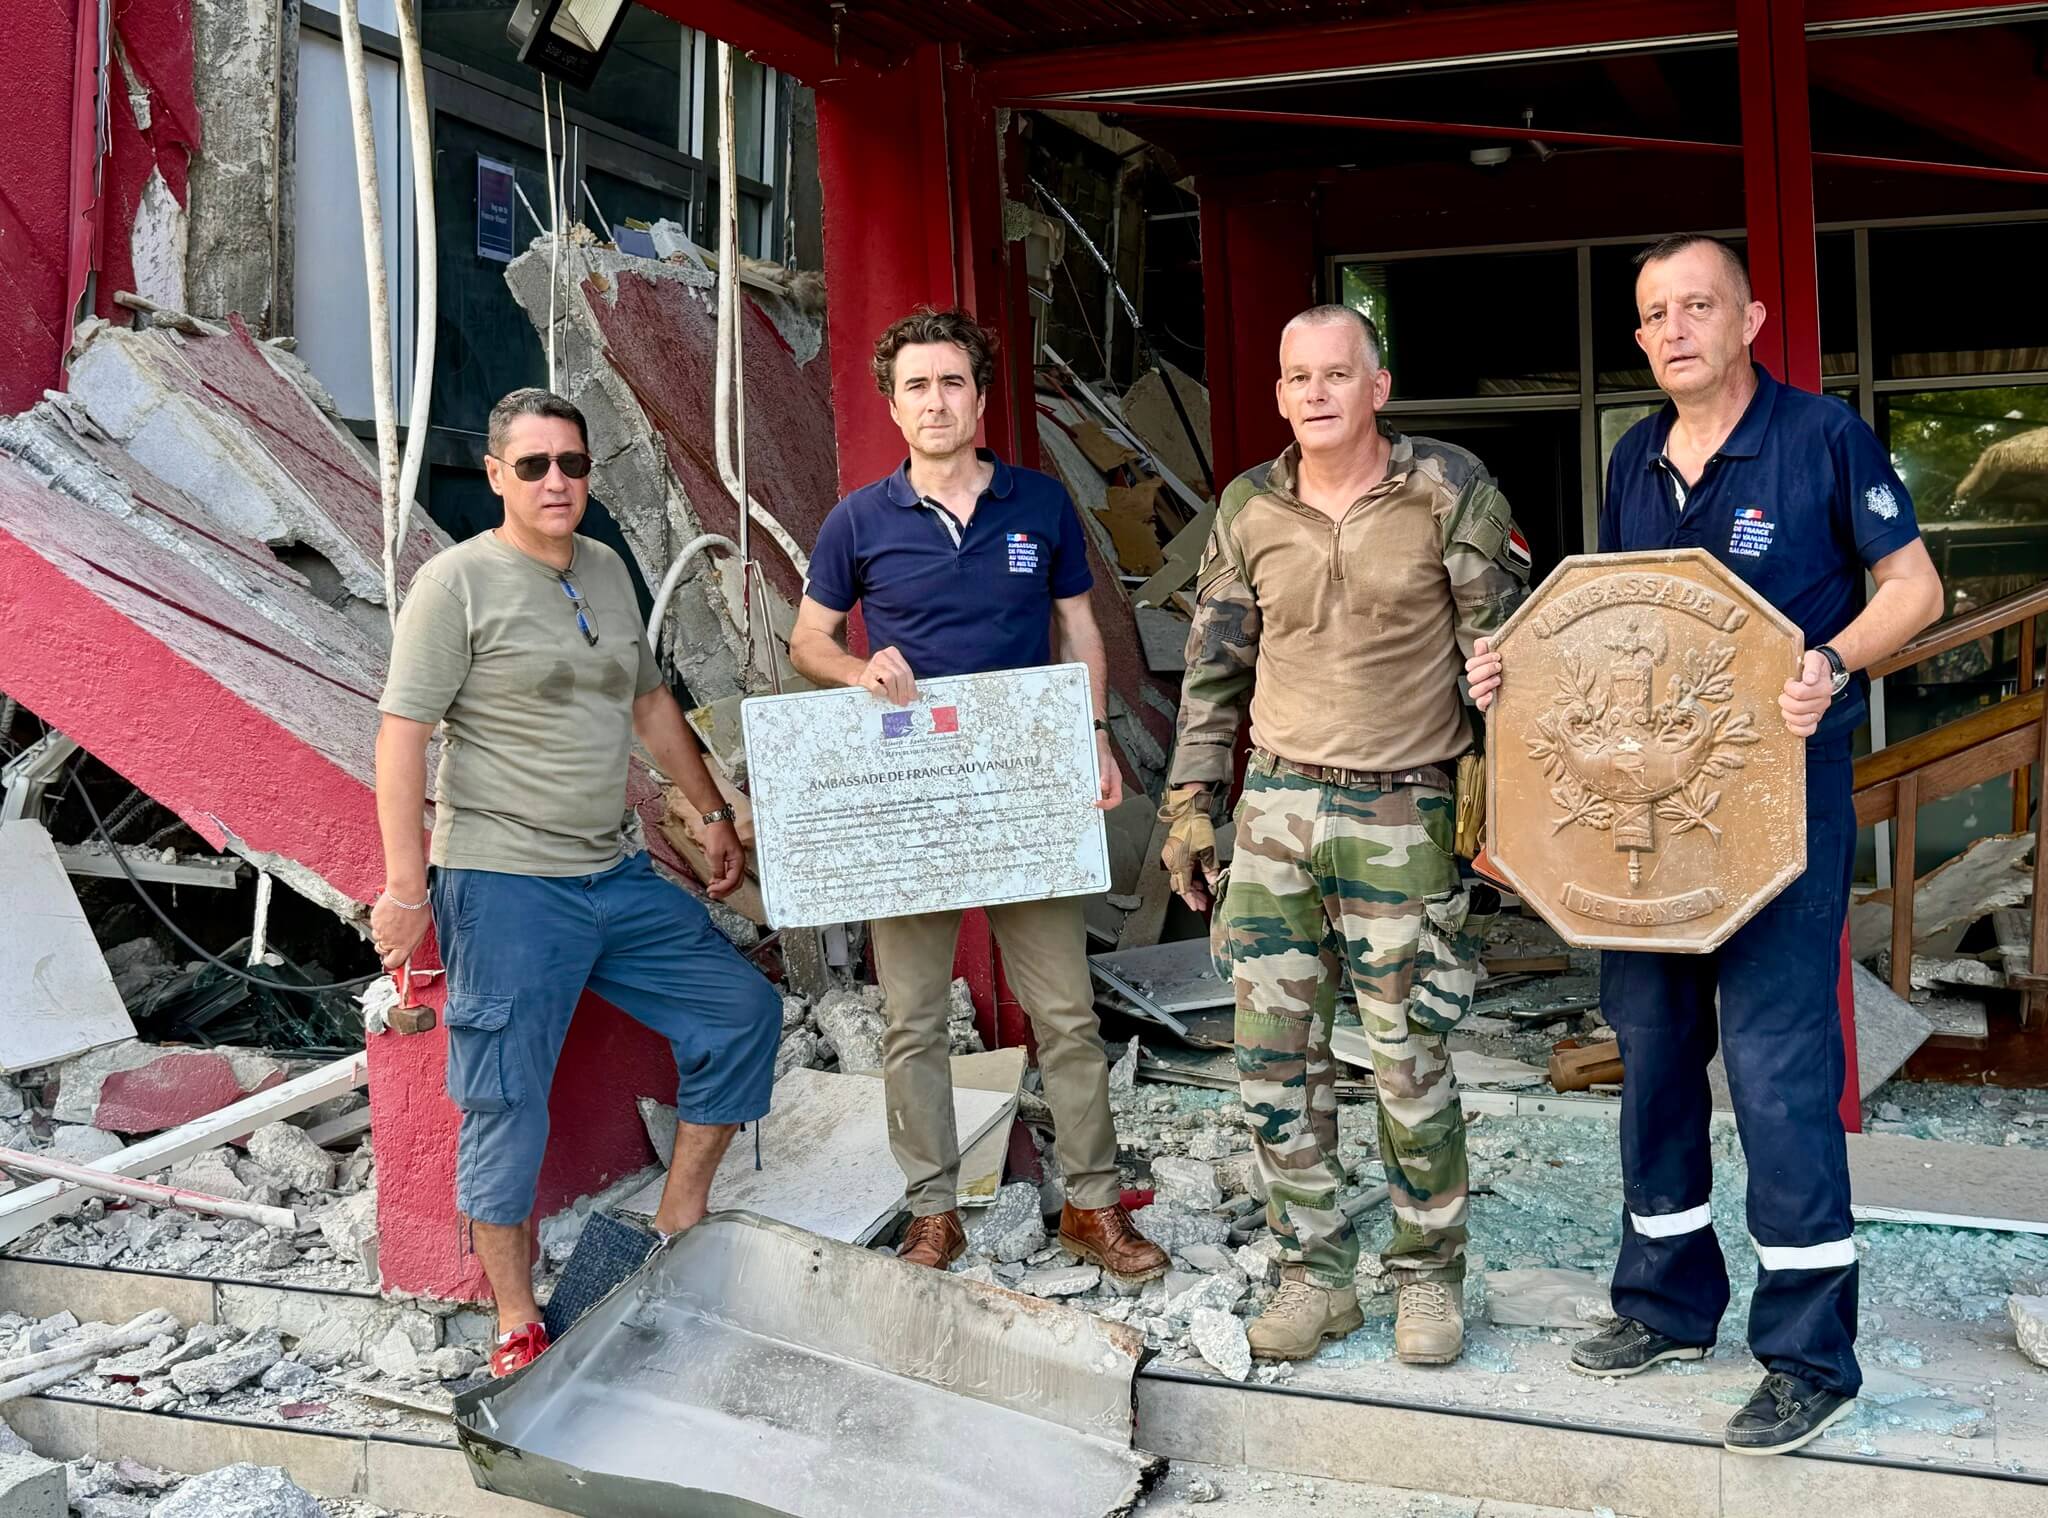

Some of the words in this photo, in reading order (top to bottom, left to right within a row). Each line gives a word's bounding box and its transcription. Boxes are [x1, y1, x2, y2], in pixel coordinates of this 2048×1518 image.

[1734, 519, 1775, 529] AMBASSADE
[1743, 527, 1769, 535] FRANCE
[1743, 534, 1773, 544] VANUATU
[1729, 547, 1760, 557] SALOMON
[1554, 578, 1715, 621] AMBASSADE
[809, 774, 888, 792] AMBASSADE
[888, 771, 905, 783] DE
[906, 766, 957, 780] FRANCE
[958, 763, 975, 774] AU
[976, 756, 1038, 773] VANUATU
[1579, 895, 1604, 918] DE
[1616, 898, 1697, 923] FRANCE
